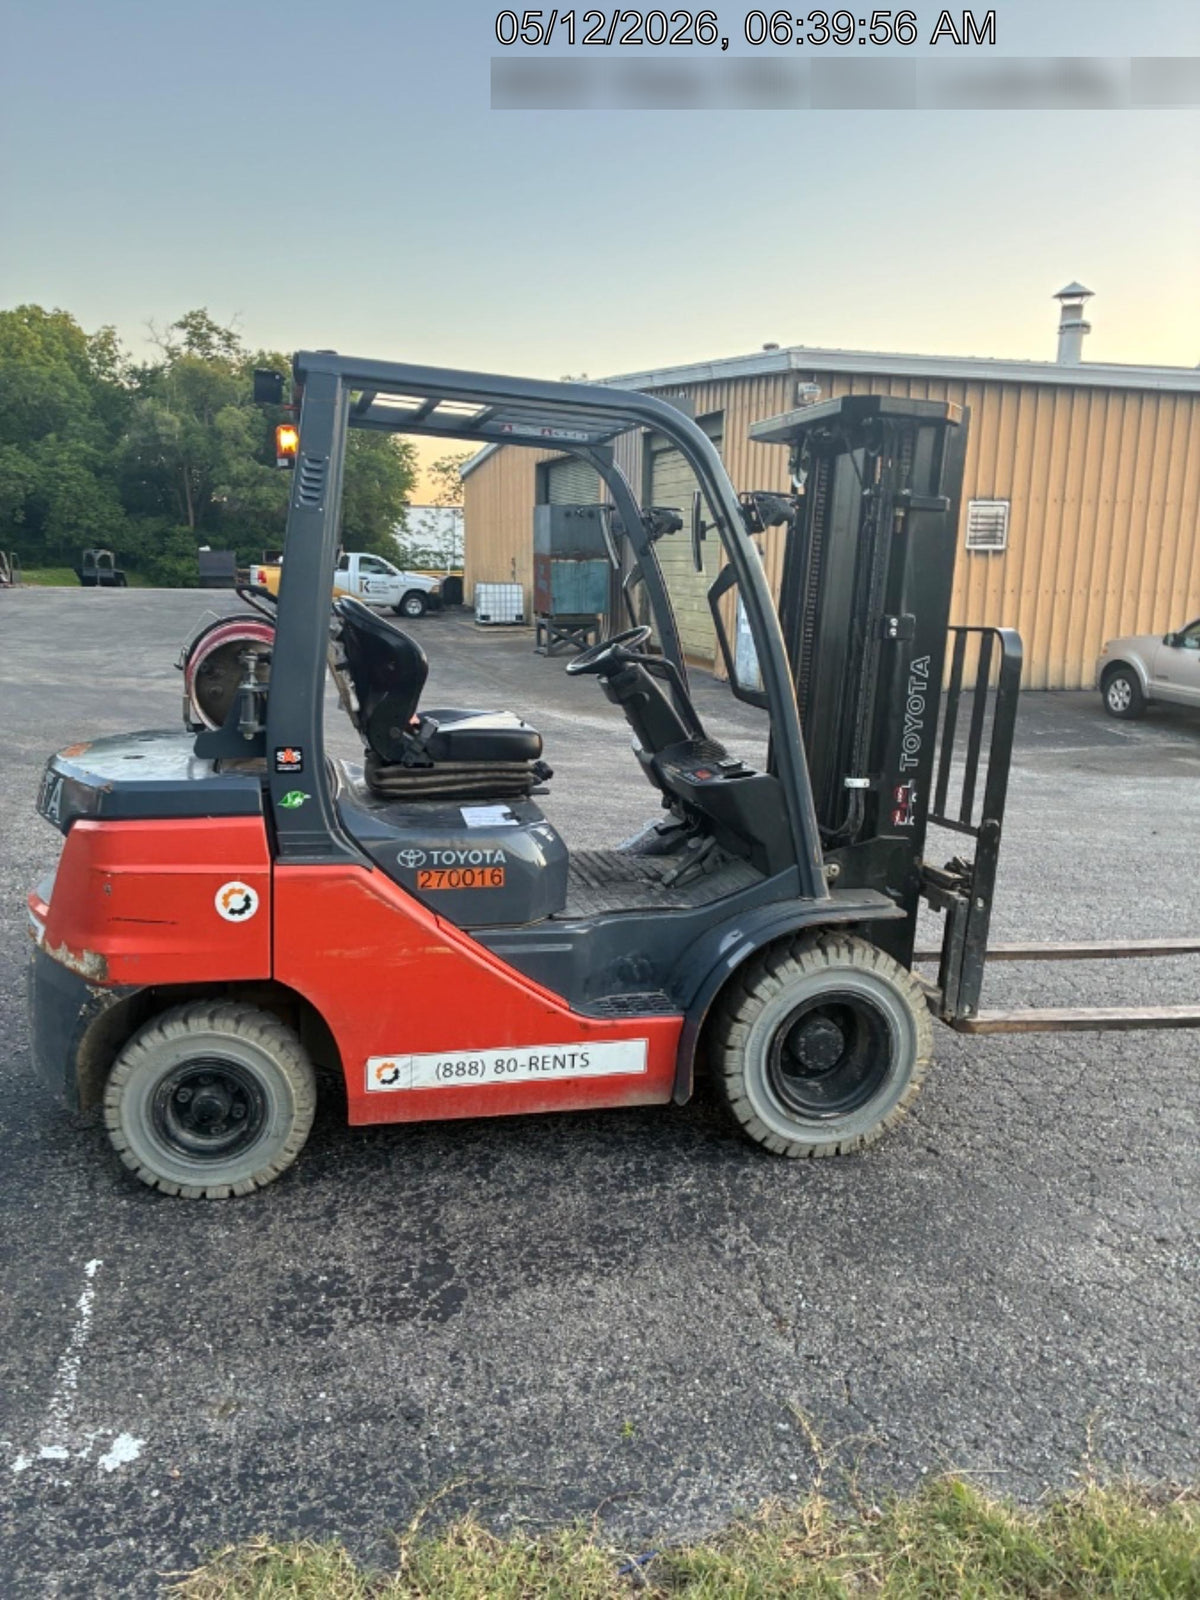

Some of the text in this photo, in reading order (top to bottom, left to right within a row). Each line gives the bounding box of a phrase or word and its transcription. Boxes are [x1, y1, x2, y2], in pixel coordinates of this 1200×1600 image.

[900, 655, 931, 771] TOYOTA
[429, 849, 507, 865] TOYOTA
[419, 868, 503, 888] 270016
[434, 1051, 590, 1081] (888) 80-RENTS
